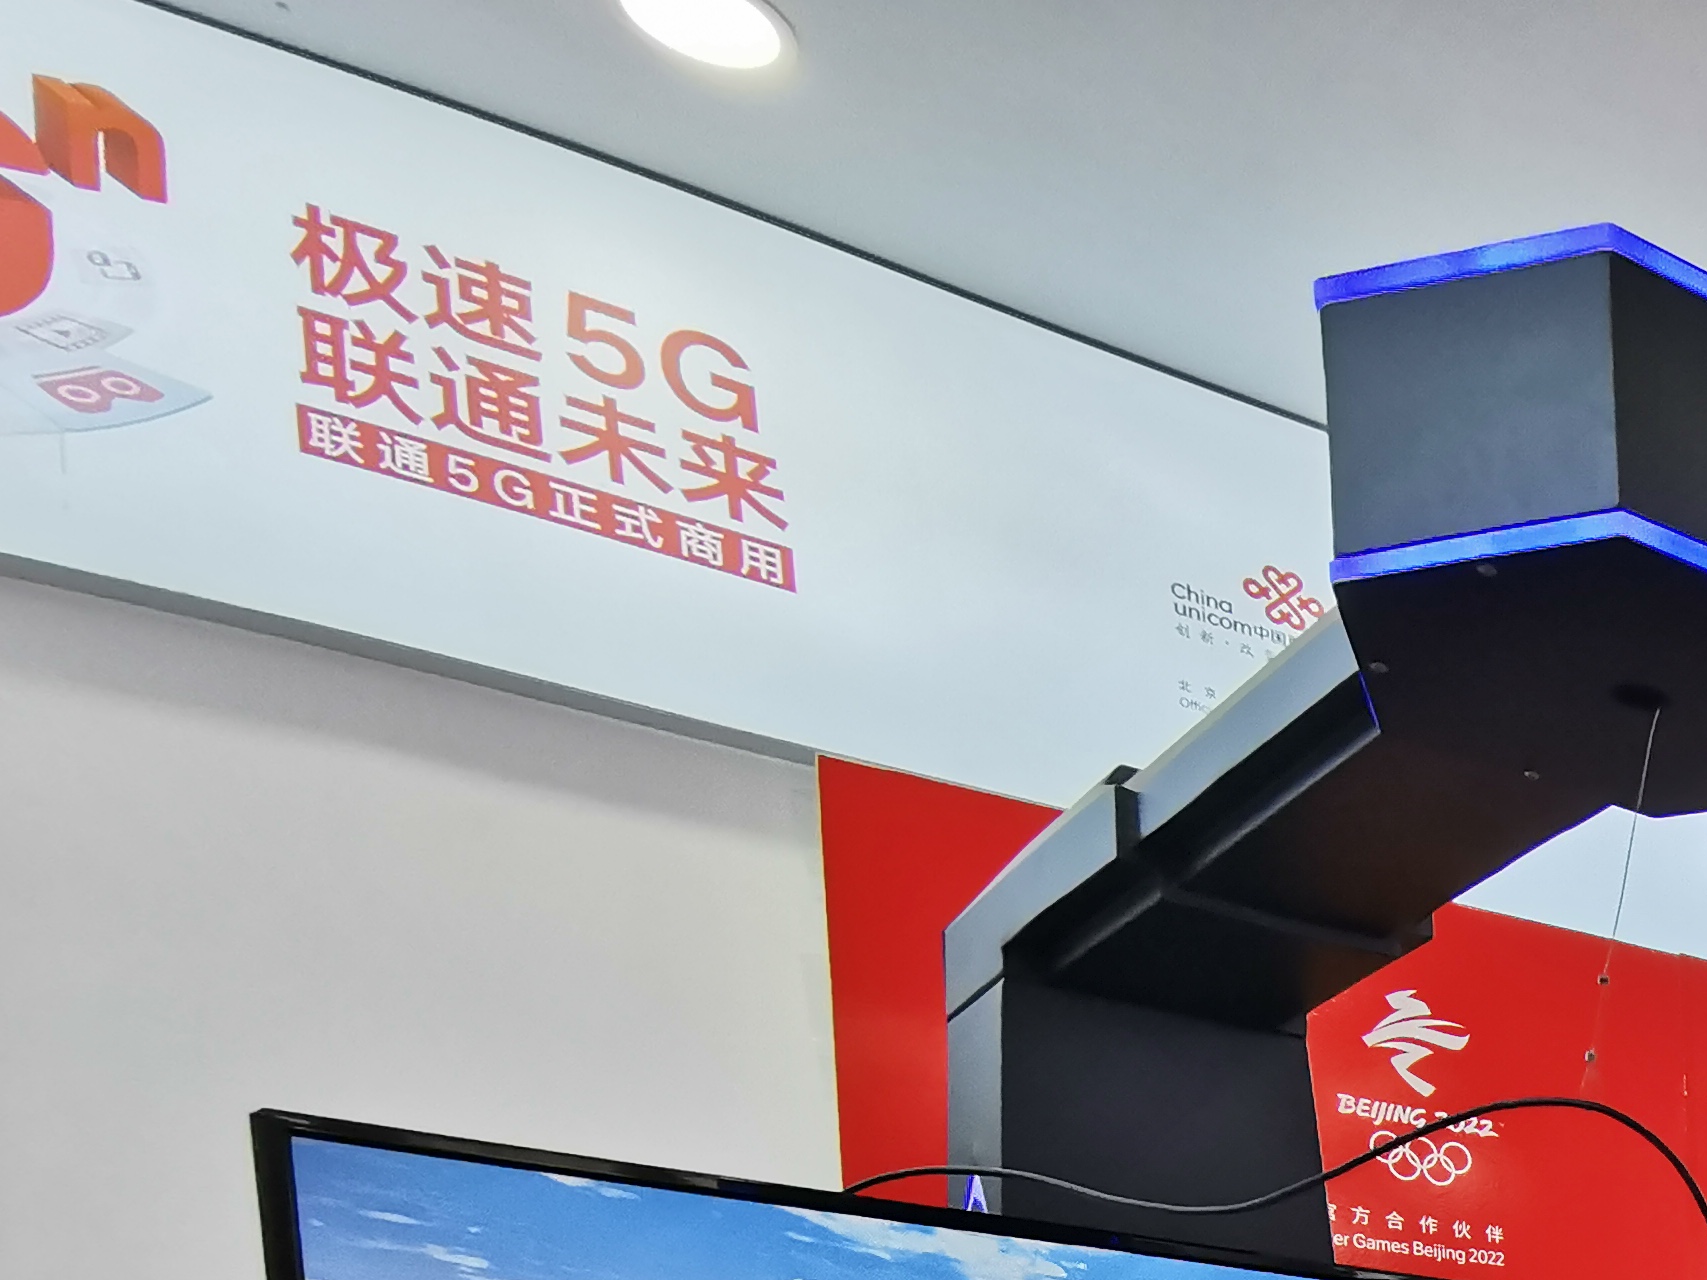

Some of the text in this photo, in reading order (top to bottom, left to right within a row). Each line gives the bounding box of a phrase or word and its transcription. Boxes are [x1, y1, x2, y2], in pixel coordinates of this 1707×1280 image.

[291, 203, 762, 432] 极速5G
[298, 306, 789, 531] 联通未来
[306, 412, 786, 587] 联通5G正式商用
[1170, 582, 1233, 614] China
[1336, 1092, 1427, 1129] BEIJING
[1352, 1233, 1410, 1256] Games
[1412, 1240, 1466, 1266] Beijing
[1468, 1247, 1505, 1267] 2022
